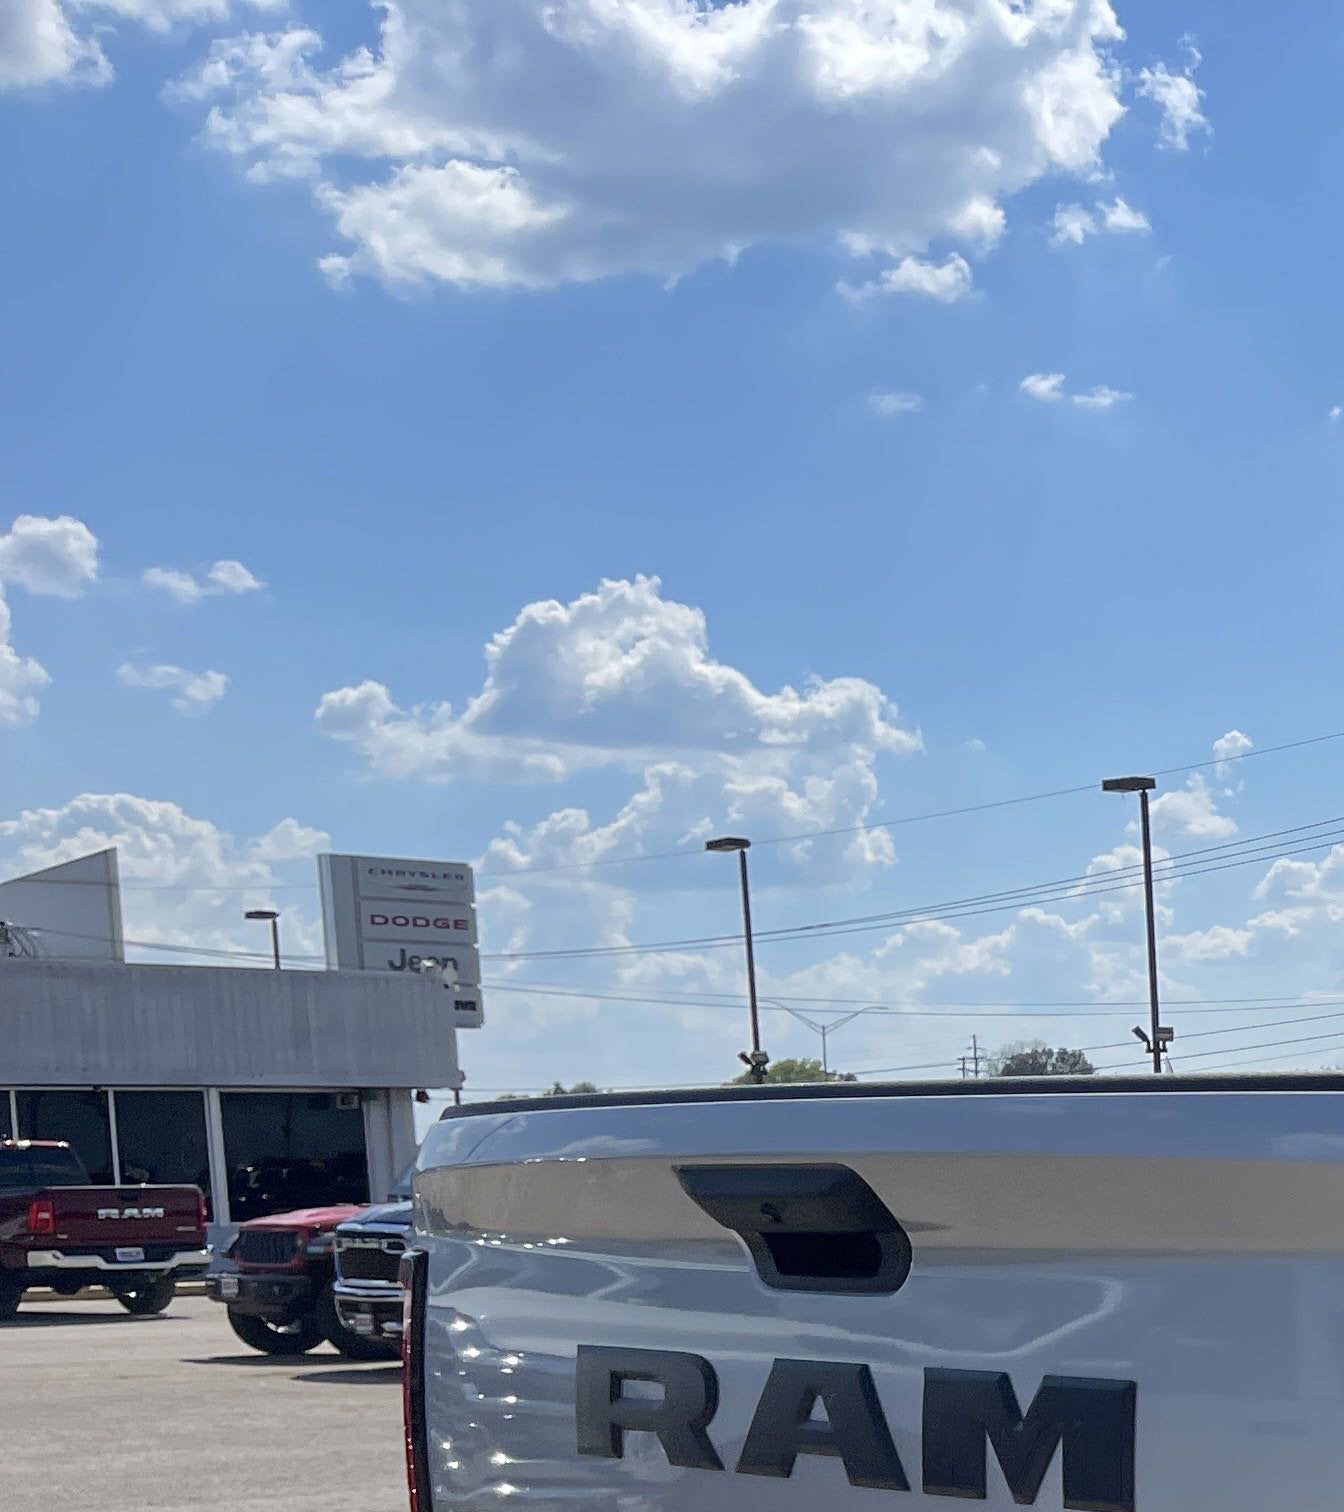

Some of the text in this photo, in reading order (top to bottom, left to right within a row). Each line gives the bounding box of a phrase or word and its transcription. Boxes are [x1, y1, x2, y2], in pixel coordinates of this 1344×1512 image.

[368, 867, 464, 881] CHRYSLER
[370, 914, 469, 931] DODGE
[97, 1207, 164, 1219] RAM
